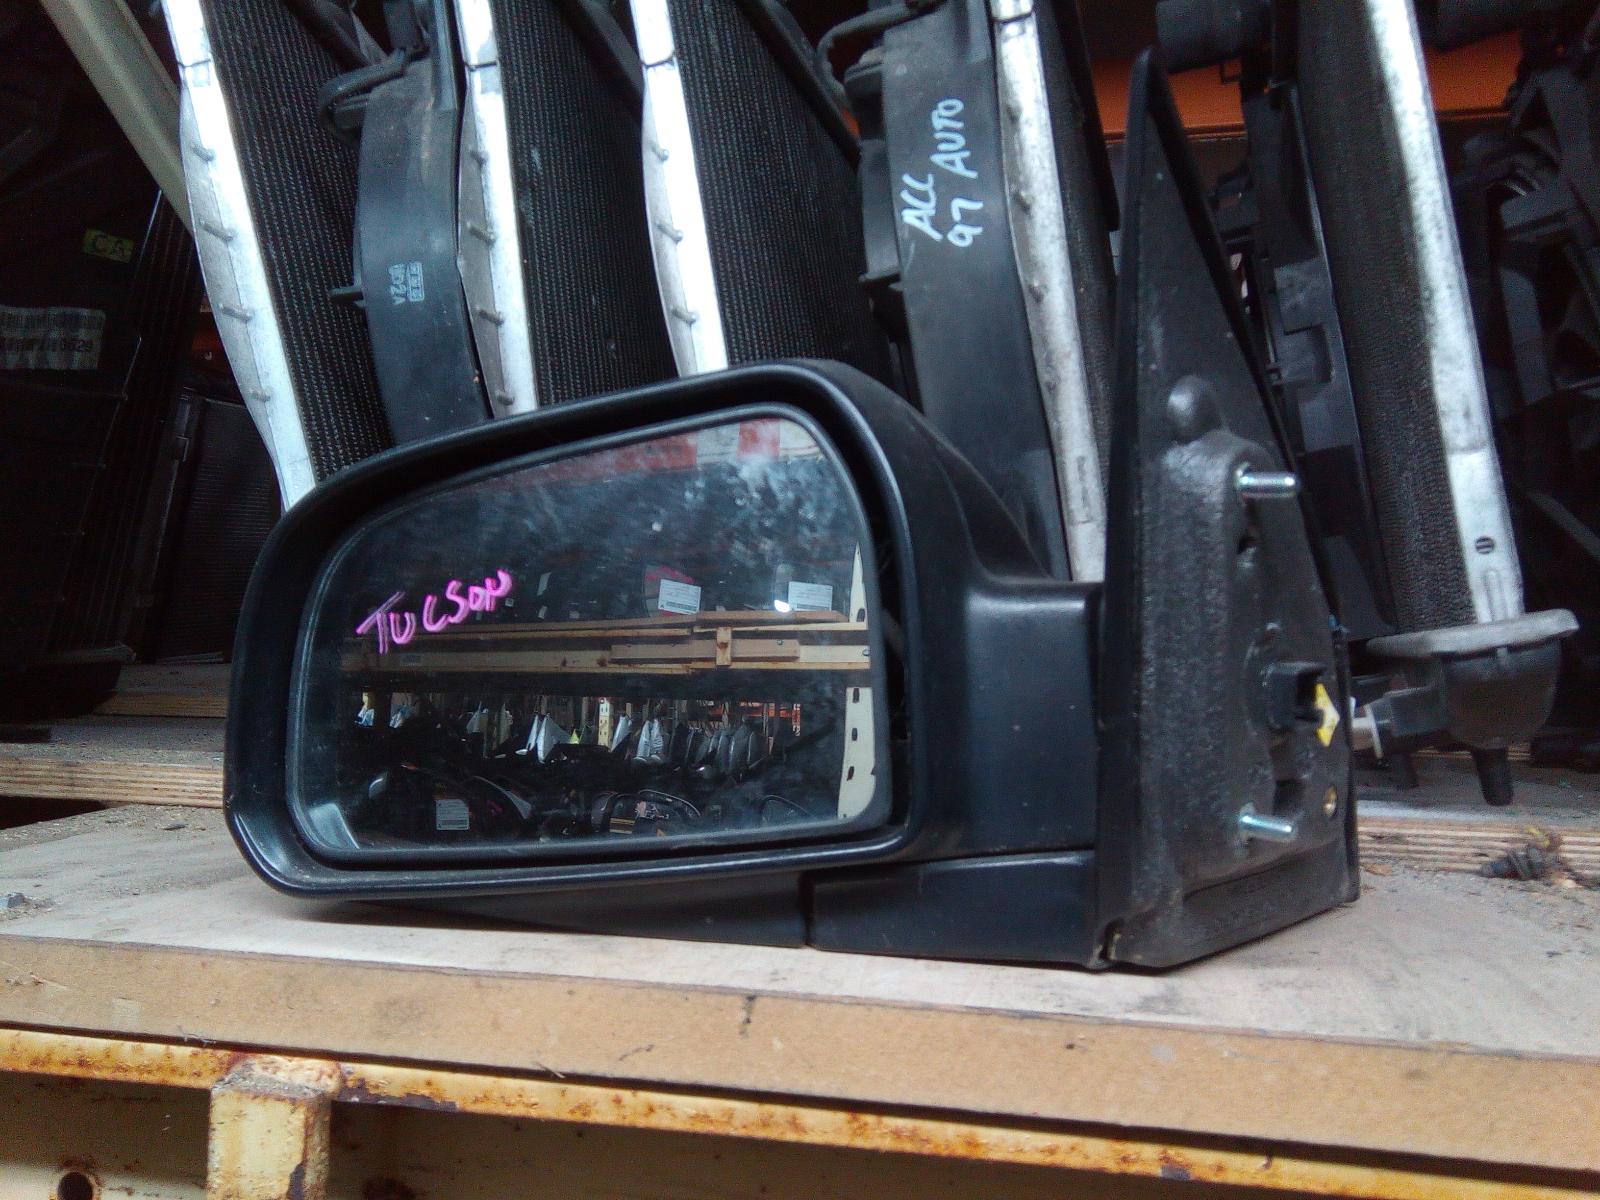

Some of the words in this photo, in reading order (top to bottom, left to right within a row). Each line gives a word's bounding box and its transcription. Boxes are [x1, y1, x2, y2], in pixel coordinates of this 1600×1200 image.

[901, 173, 943, 242] ALL
[930, 99, 978, 179] AUTO
[947, 198, 984, 247] 97
[356, 568, 512, 654] TUCSON
